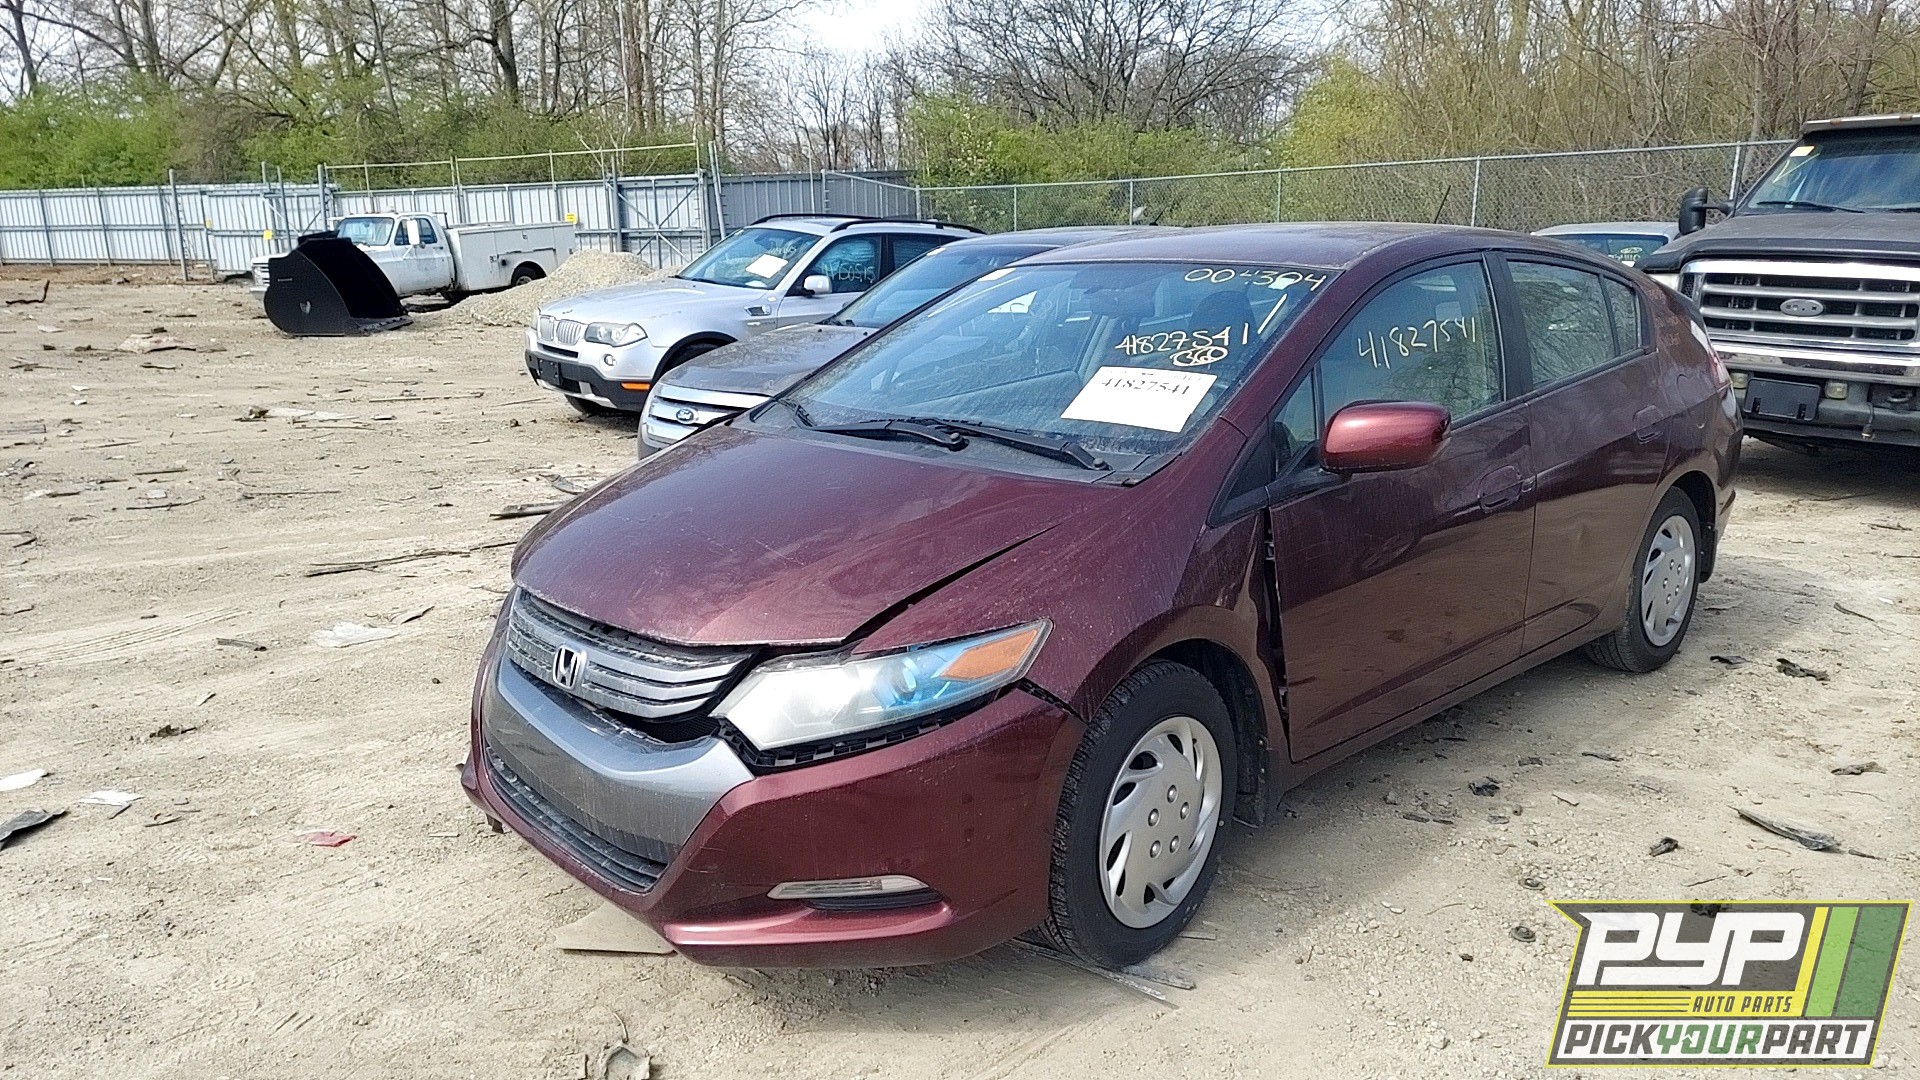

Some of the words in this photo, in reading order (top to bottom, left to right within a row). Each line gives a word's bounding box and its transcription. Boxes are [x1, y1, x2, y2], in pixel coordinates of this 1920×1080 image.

[1114, 323, 1249, 355] 41827541
[1357, 316, 1476, 369] 41827541
[1101, 377, 1190, 395] 41827541
